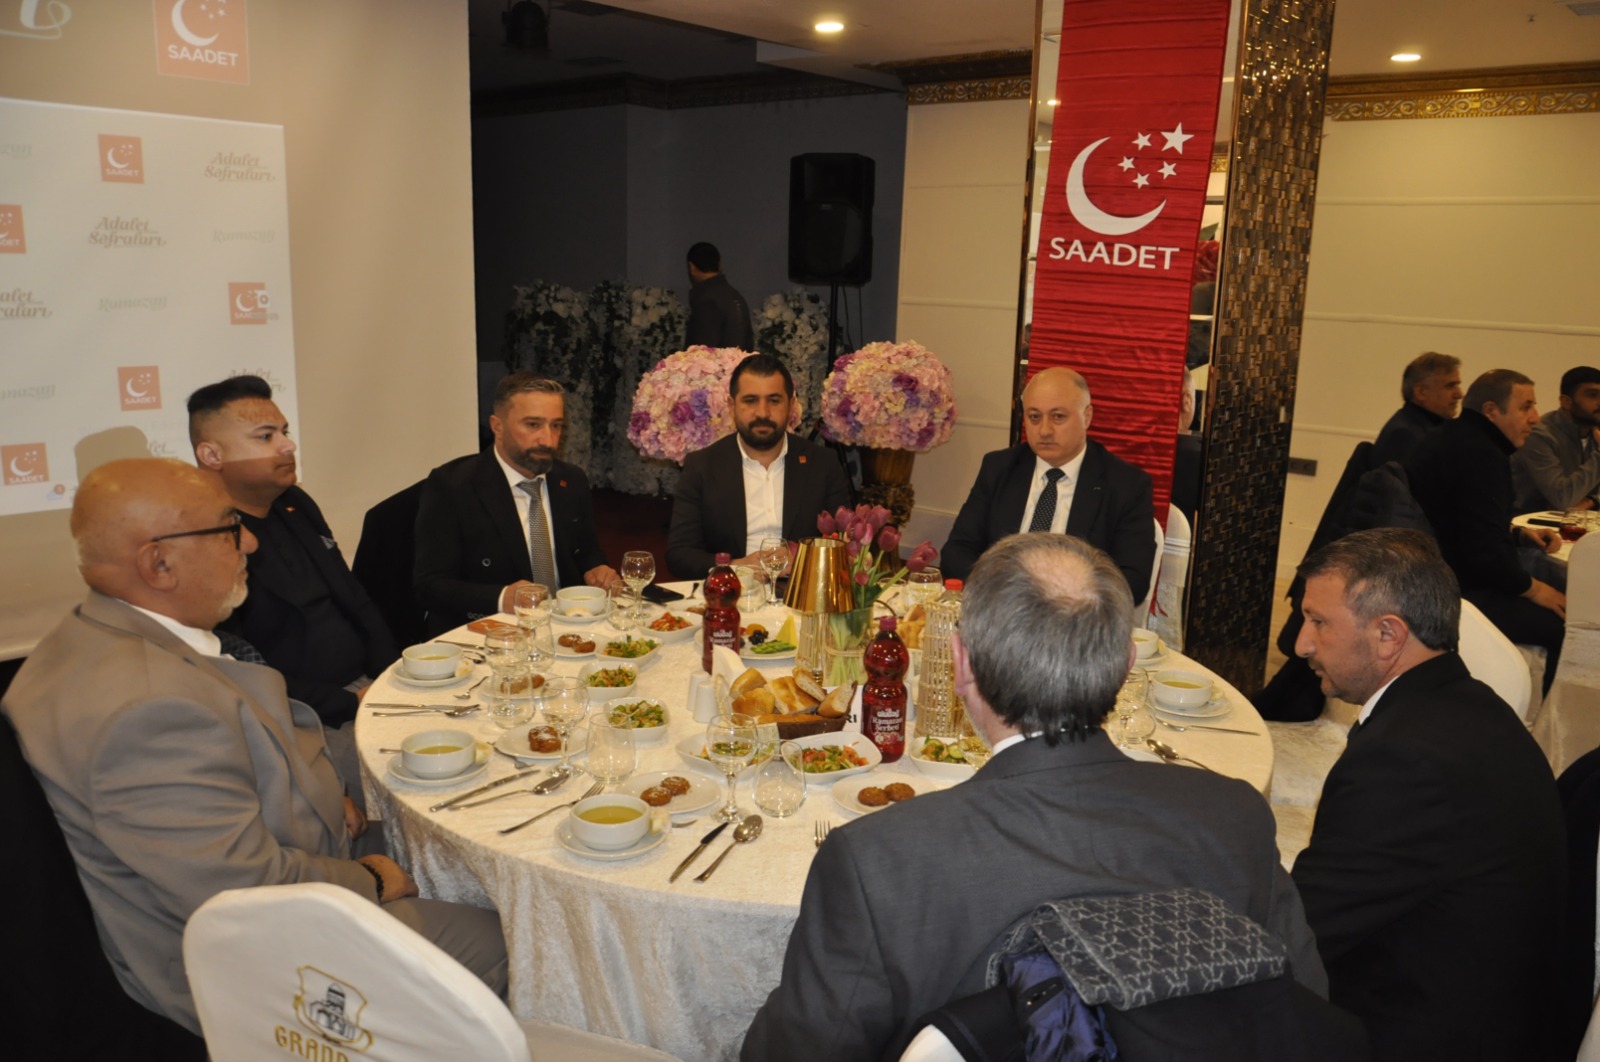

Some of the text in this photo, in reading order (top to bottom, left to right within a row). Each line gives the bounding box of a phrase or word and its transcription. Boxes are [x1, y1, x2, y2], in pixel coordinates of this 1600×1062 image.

[167, 44, 239, 67] SAADET
[105, 168, 139, 177] SAADET
[96, 216, 150, 232] Adalet
[1048, 236, 1180, 270] SAADET
[125, 396, 157, 405] SAADET
